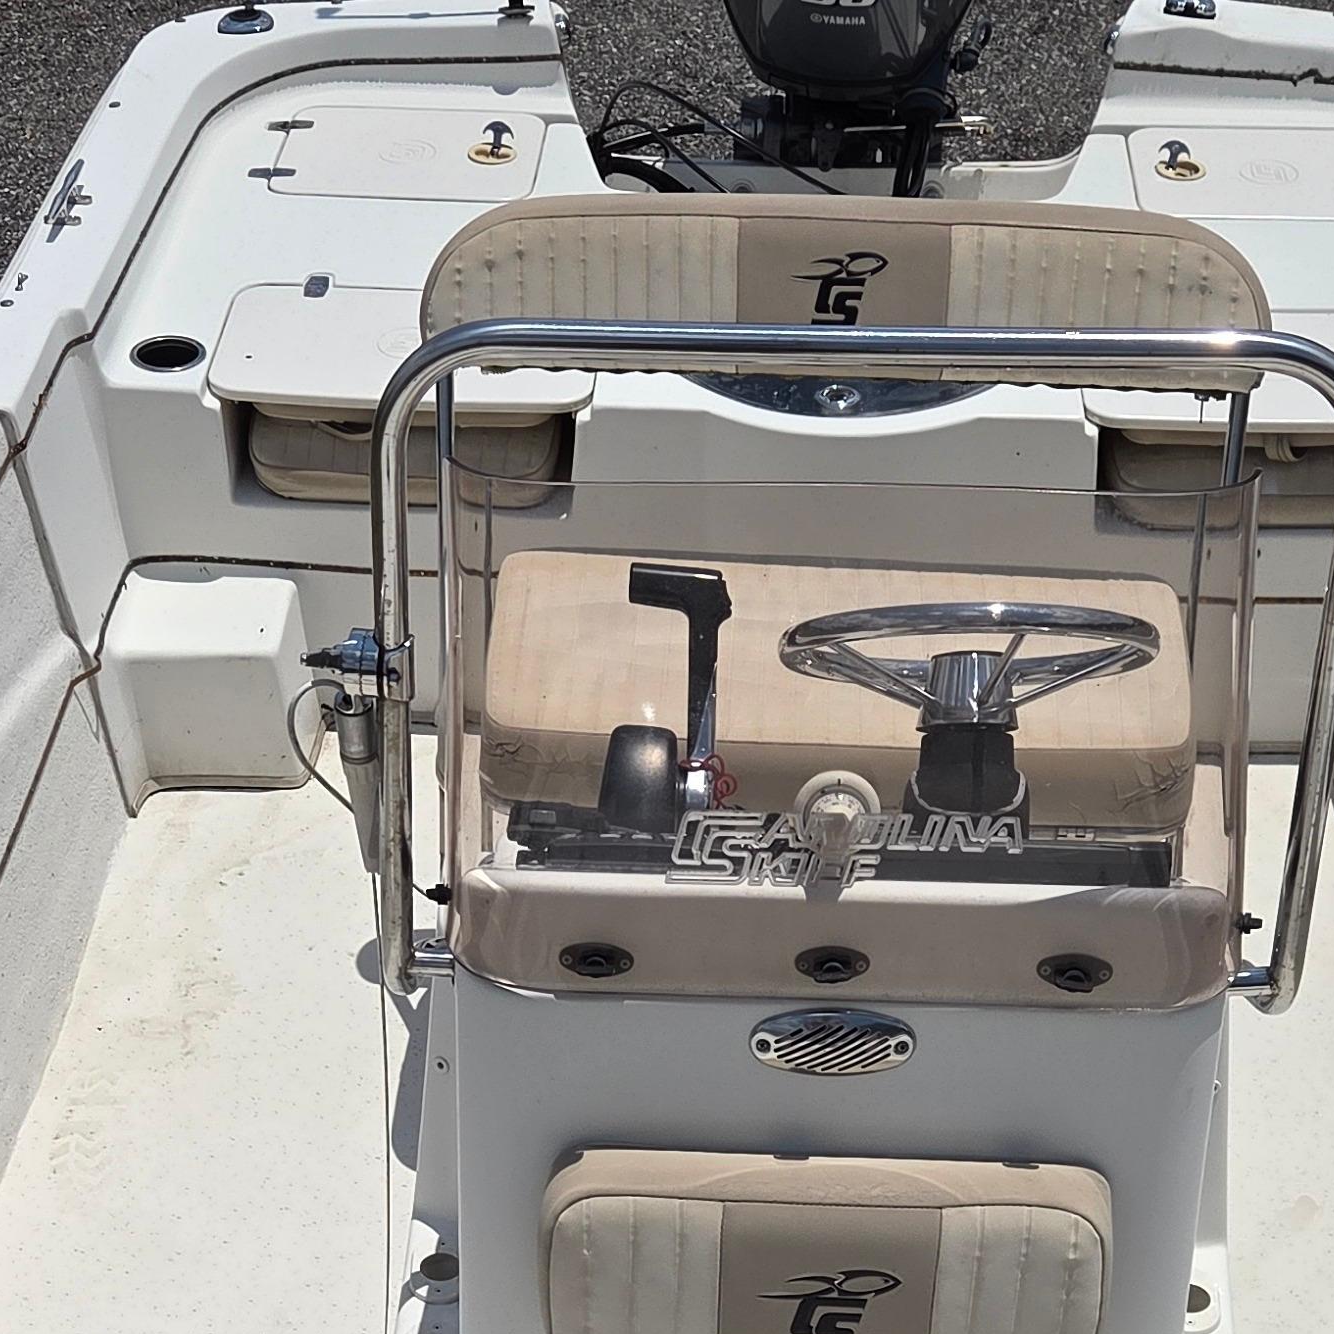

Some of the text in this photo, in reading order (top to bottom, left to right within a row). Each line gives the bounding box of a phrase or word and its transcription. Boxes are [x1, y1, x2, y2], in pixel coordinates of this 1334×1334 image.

[822, 15, 866, 25] YAMAHA
[665, 830, 881, 887] SKIF
[671, 811, 1023, 866] CAOLINA
